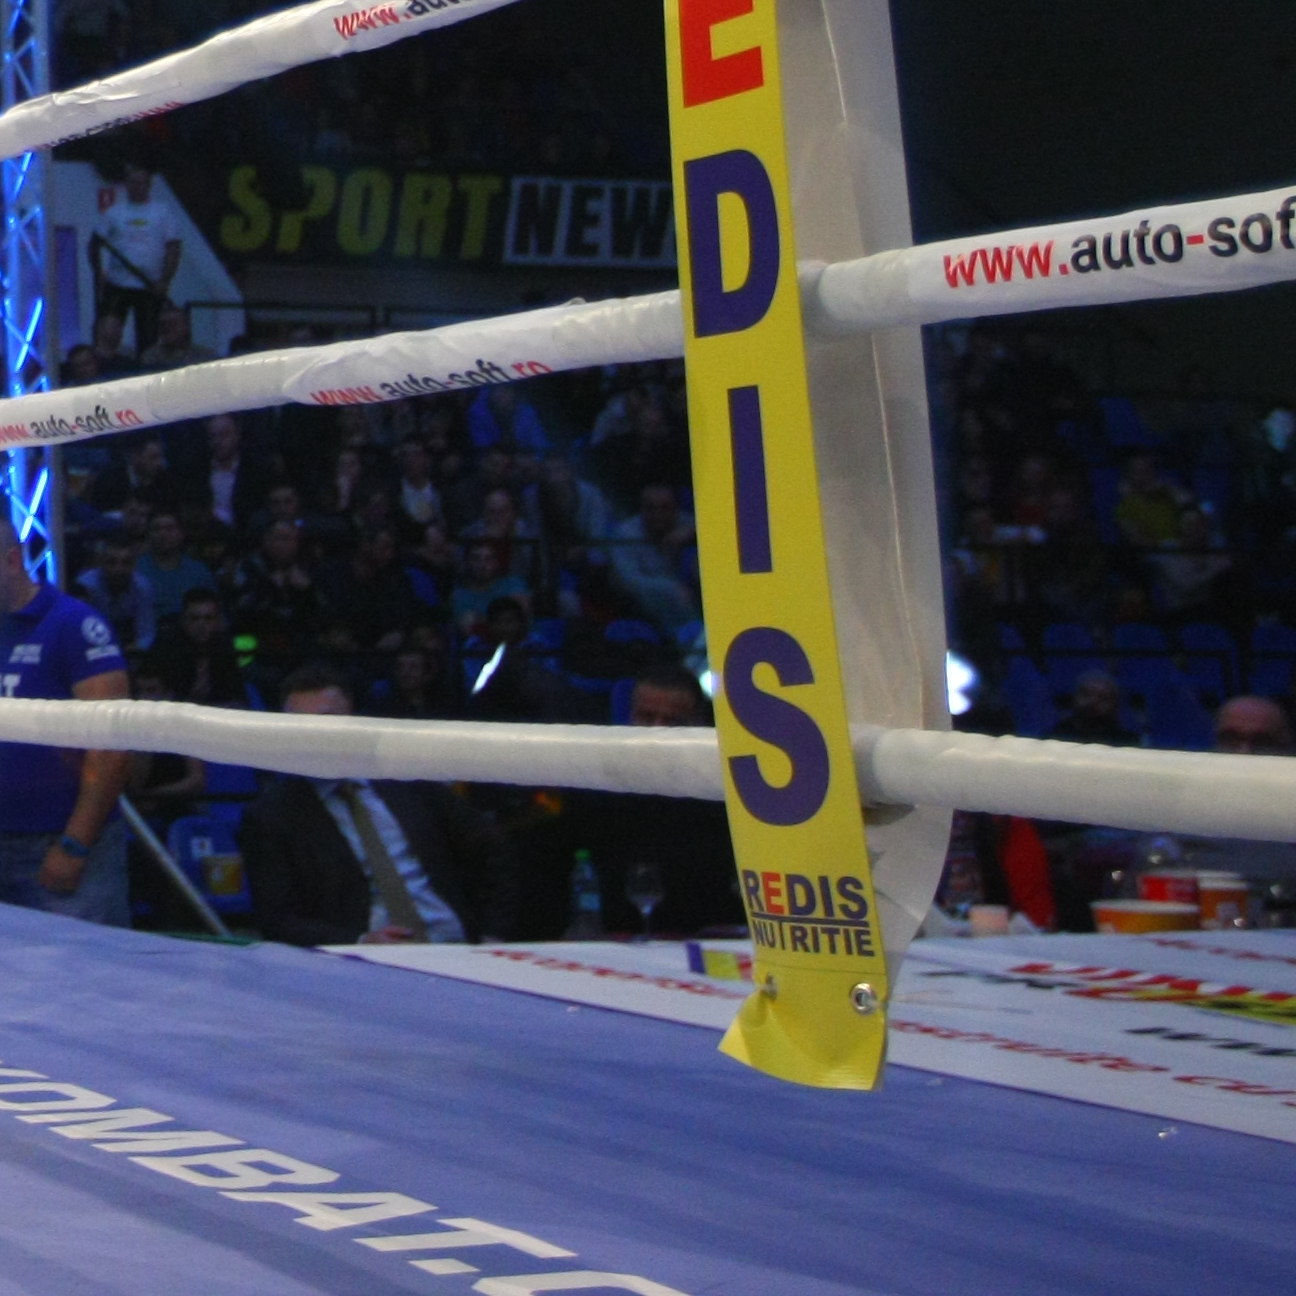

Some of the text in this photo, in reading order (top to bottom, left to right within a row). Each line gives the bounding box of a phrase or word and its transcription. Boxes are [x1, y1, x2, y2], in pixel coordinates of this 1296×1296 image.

[219, 165, 672, 265] SPORT NEW
[943, 195, 1296, 289] www.auto-sof
[744, 869, 868, 919] REDIS
[753, 920, 876, 958] NUTRITIE
